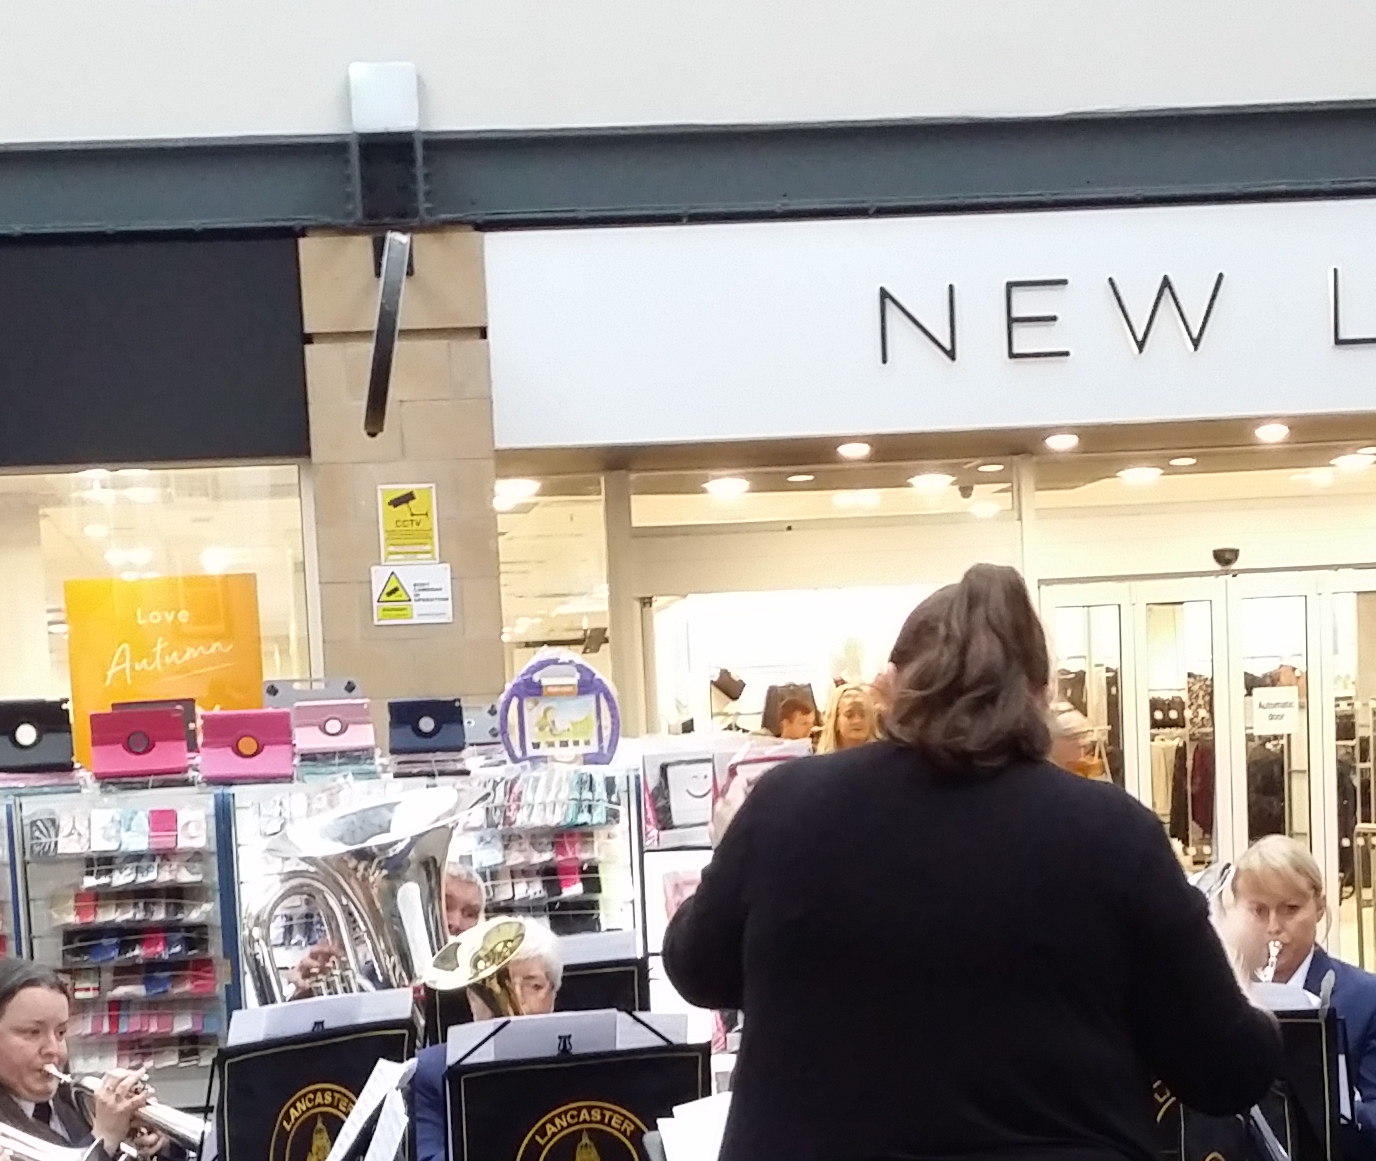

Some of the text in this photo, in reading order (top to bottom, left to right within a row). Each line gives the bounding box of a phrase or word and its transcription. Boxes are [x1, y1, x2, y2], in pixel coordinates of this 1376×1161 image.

[878, 270, 1225, 365] NEW
[395, 519, 422, 528] CCTV
[136, 608, 190, 625] Love
[105, 637, 234, 686] Autumn
[534, 1107, 636, 1146] LANCASTER
